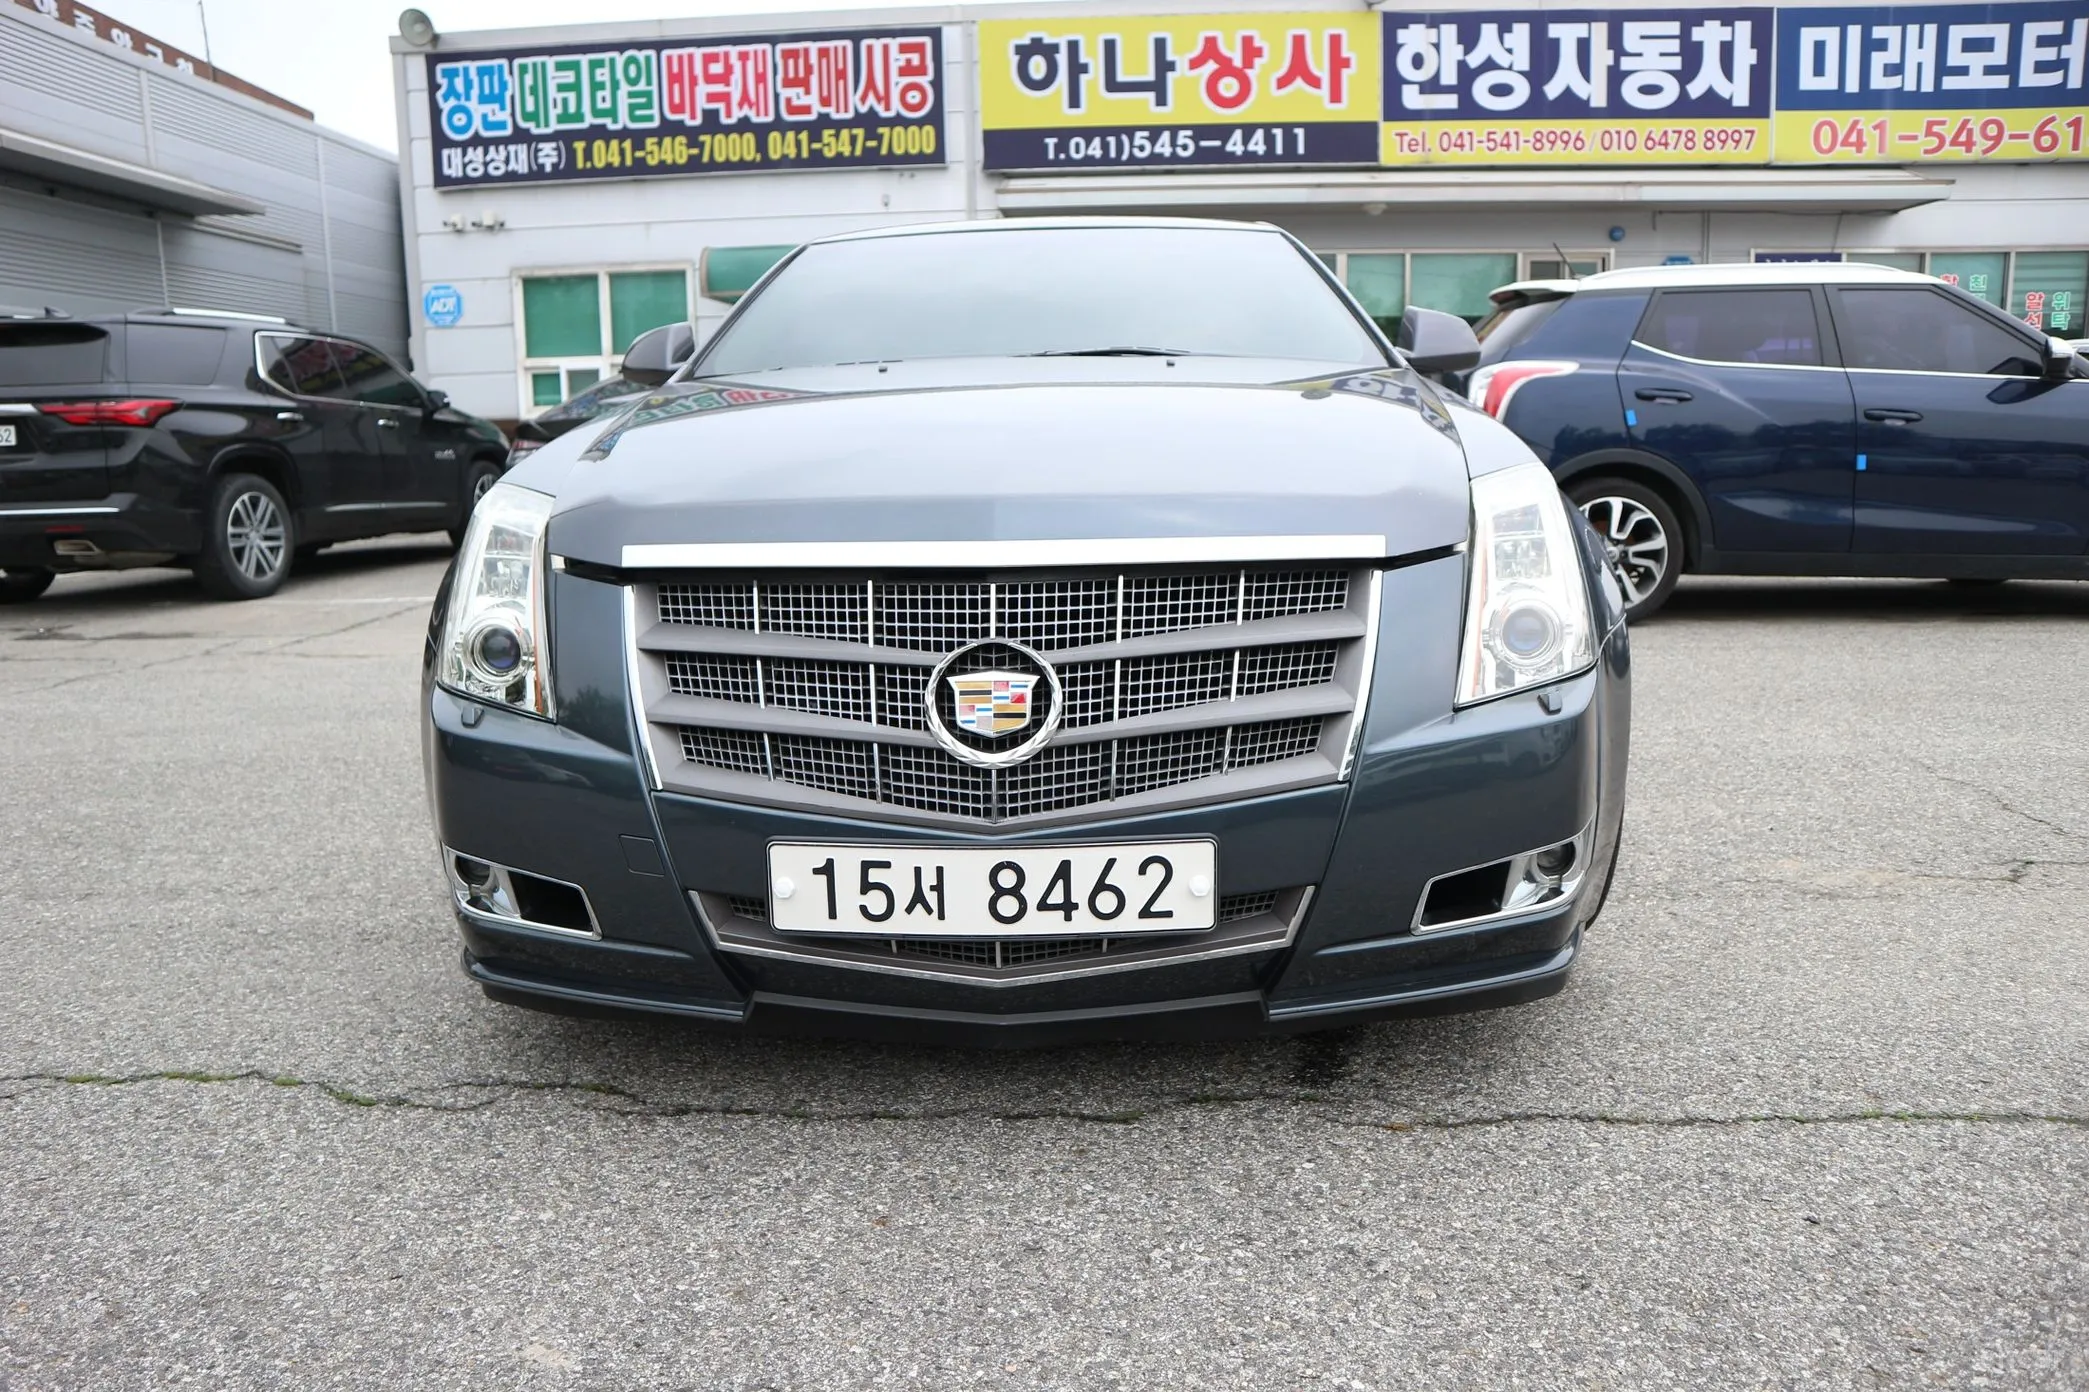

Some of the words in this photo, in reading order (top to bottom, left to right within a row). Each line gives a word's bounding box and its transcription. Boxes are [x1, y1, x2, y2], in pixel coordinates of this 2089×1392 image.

[1014, 33, 1352, 109] 하나상사
[1799, 18, 2089, 93] 미래모터
[437, 60, 512, 138] 장판
[514, 51, 659, 132] 데코타일
[662, 46, 773, 123] 바닥재
[441, 140, 567, 178] 대성상재(주)
[767, 124, 936, 161] 041-547-7000
[1044, 127, 1306, 161] T.041)545-4411
[1394, 131, 1432, 153] Tel.
[1644, 128, 1697, 151] 6478
[1703, 128, 1757, 151] 8997
[811, 857, 946, 923] 15서
[988, 855, 1175, 925] 8462
